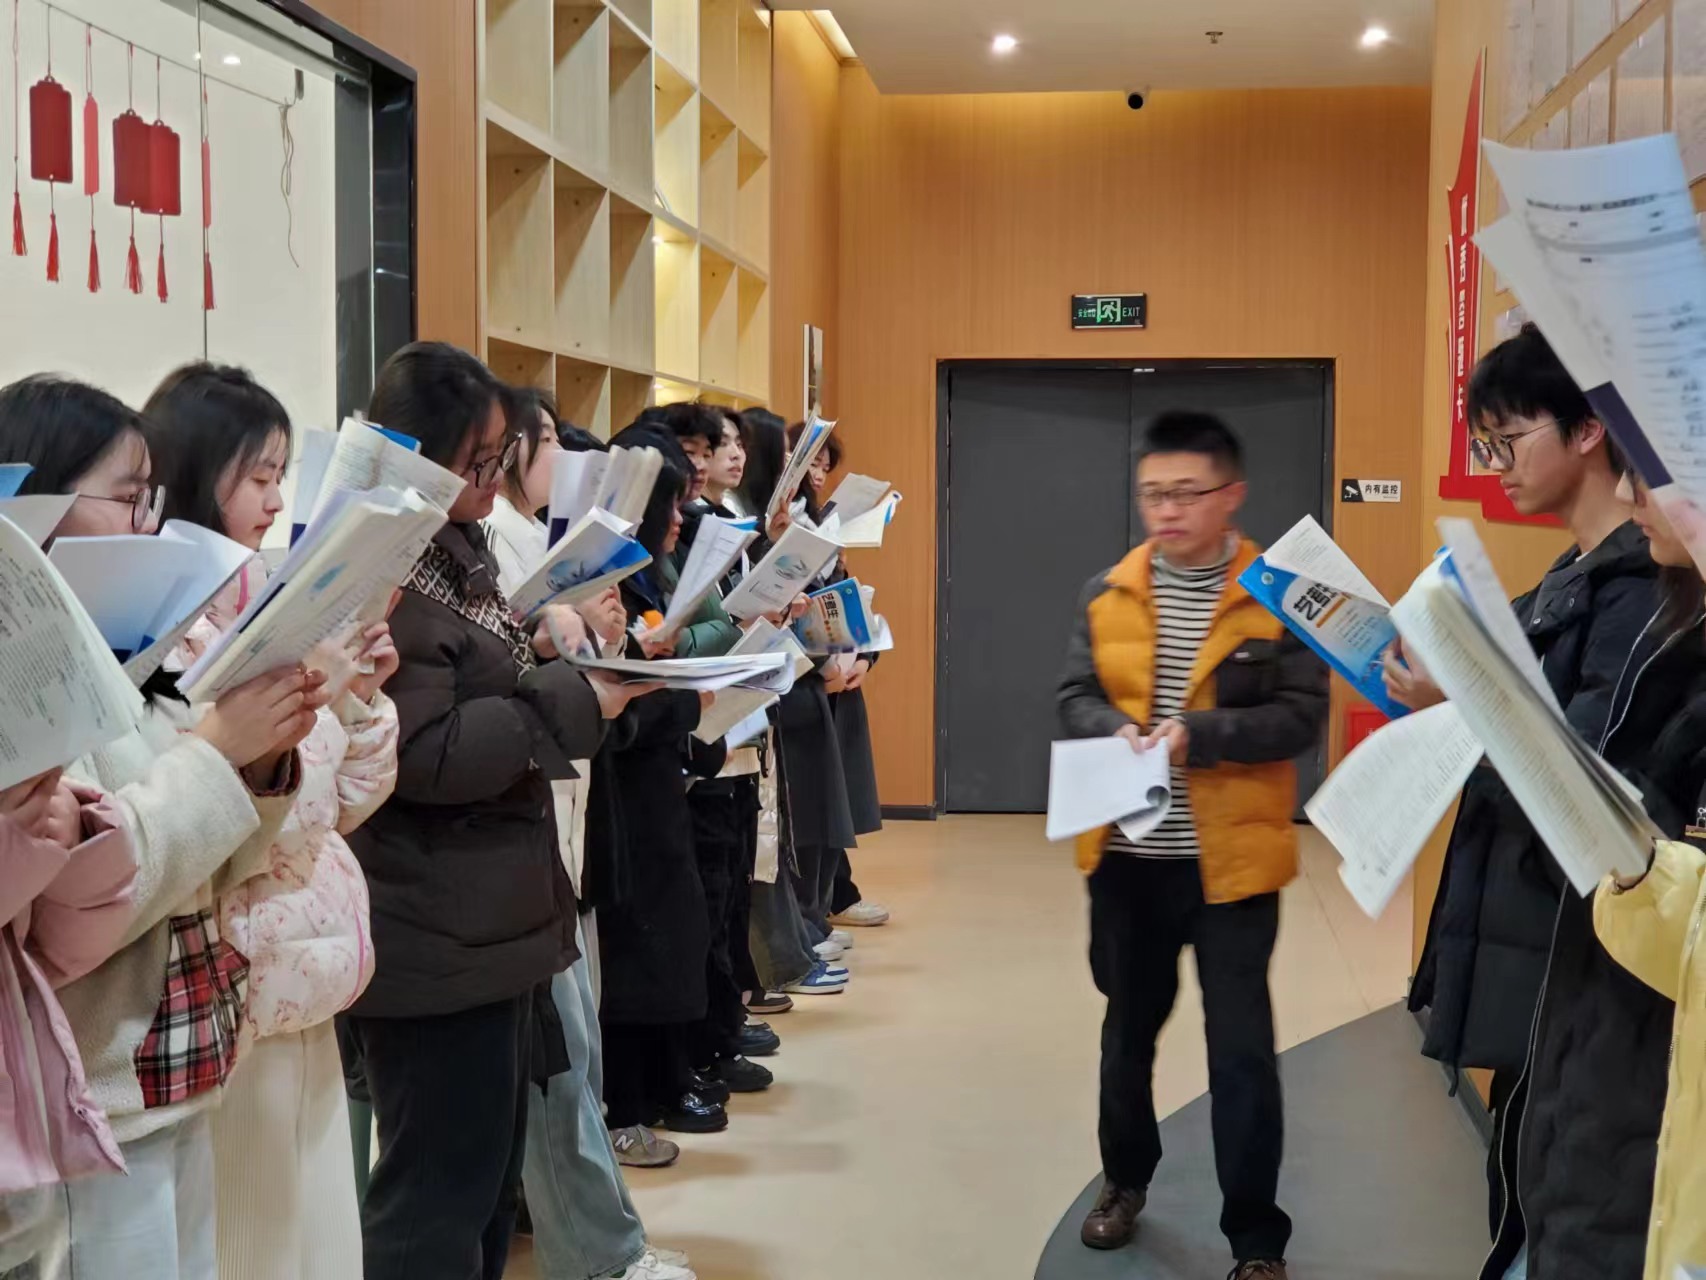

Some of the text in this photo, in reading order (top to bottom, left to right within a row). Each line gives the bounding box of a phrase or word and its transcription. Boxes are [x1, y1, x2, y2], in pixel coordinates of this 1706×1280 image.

[1122, 307, 1140, 317] EXIT
[1365, 484, 1398, 494] 内有监控
[615, 1134, 635, 1151] N
